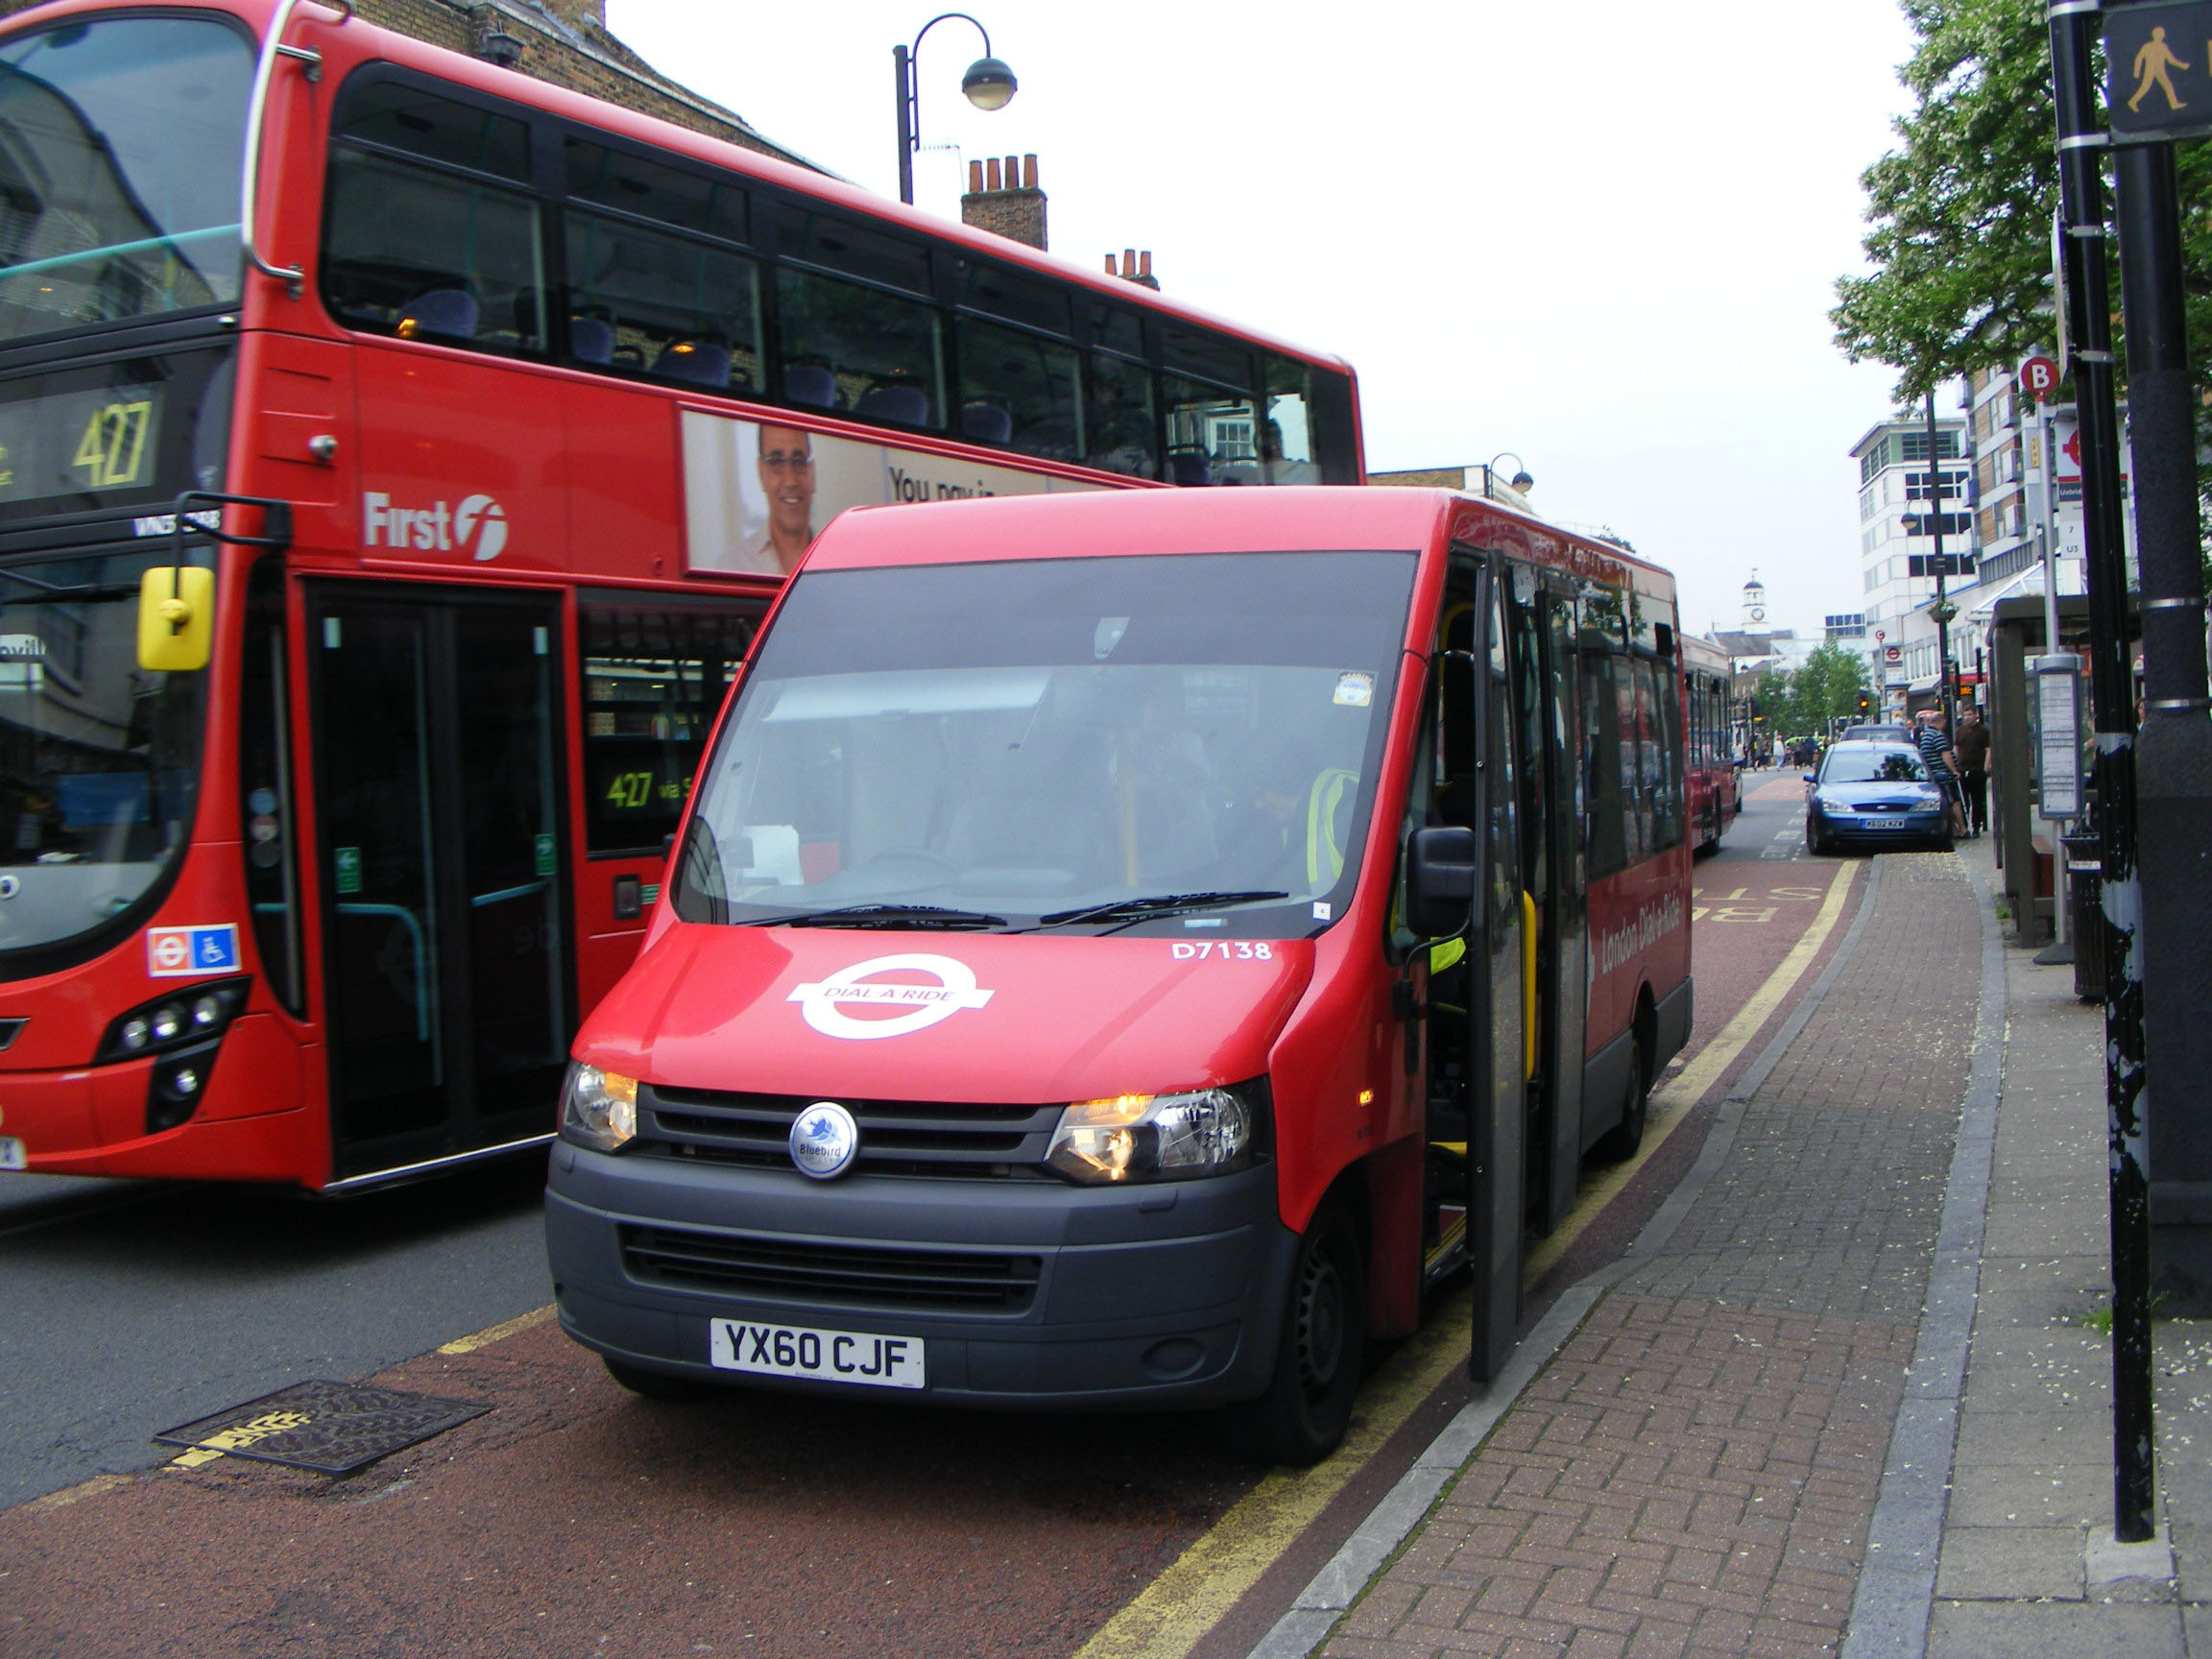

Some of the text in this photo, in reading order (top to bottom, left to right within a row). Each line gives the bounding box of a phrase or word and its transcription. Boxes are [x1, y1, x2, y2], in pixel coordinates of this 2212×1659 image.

[2032, 364, 2051, 389] B
[72, 400, 153, 487] 427
[889, 466, 930, 503] You
[364, 491, 452, 551] First
[606, 772, 653, 807] 427
[1171, 941, 1273, 961] D7138
[1601, 917, 1638, 975] London
[800, 1143, 842, 1158] Bluebird
[725, 1323, 909, 1378] YX60 CJF
